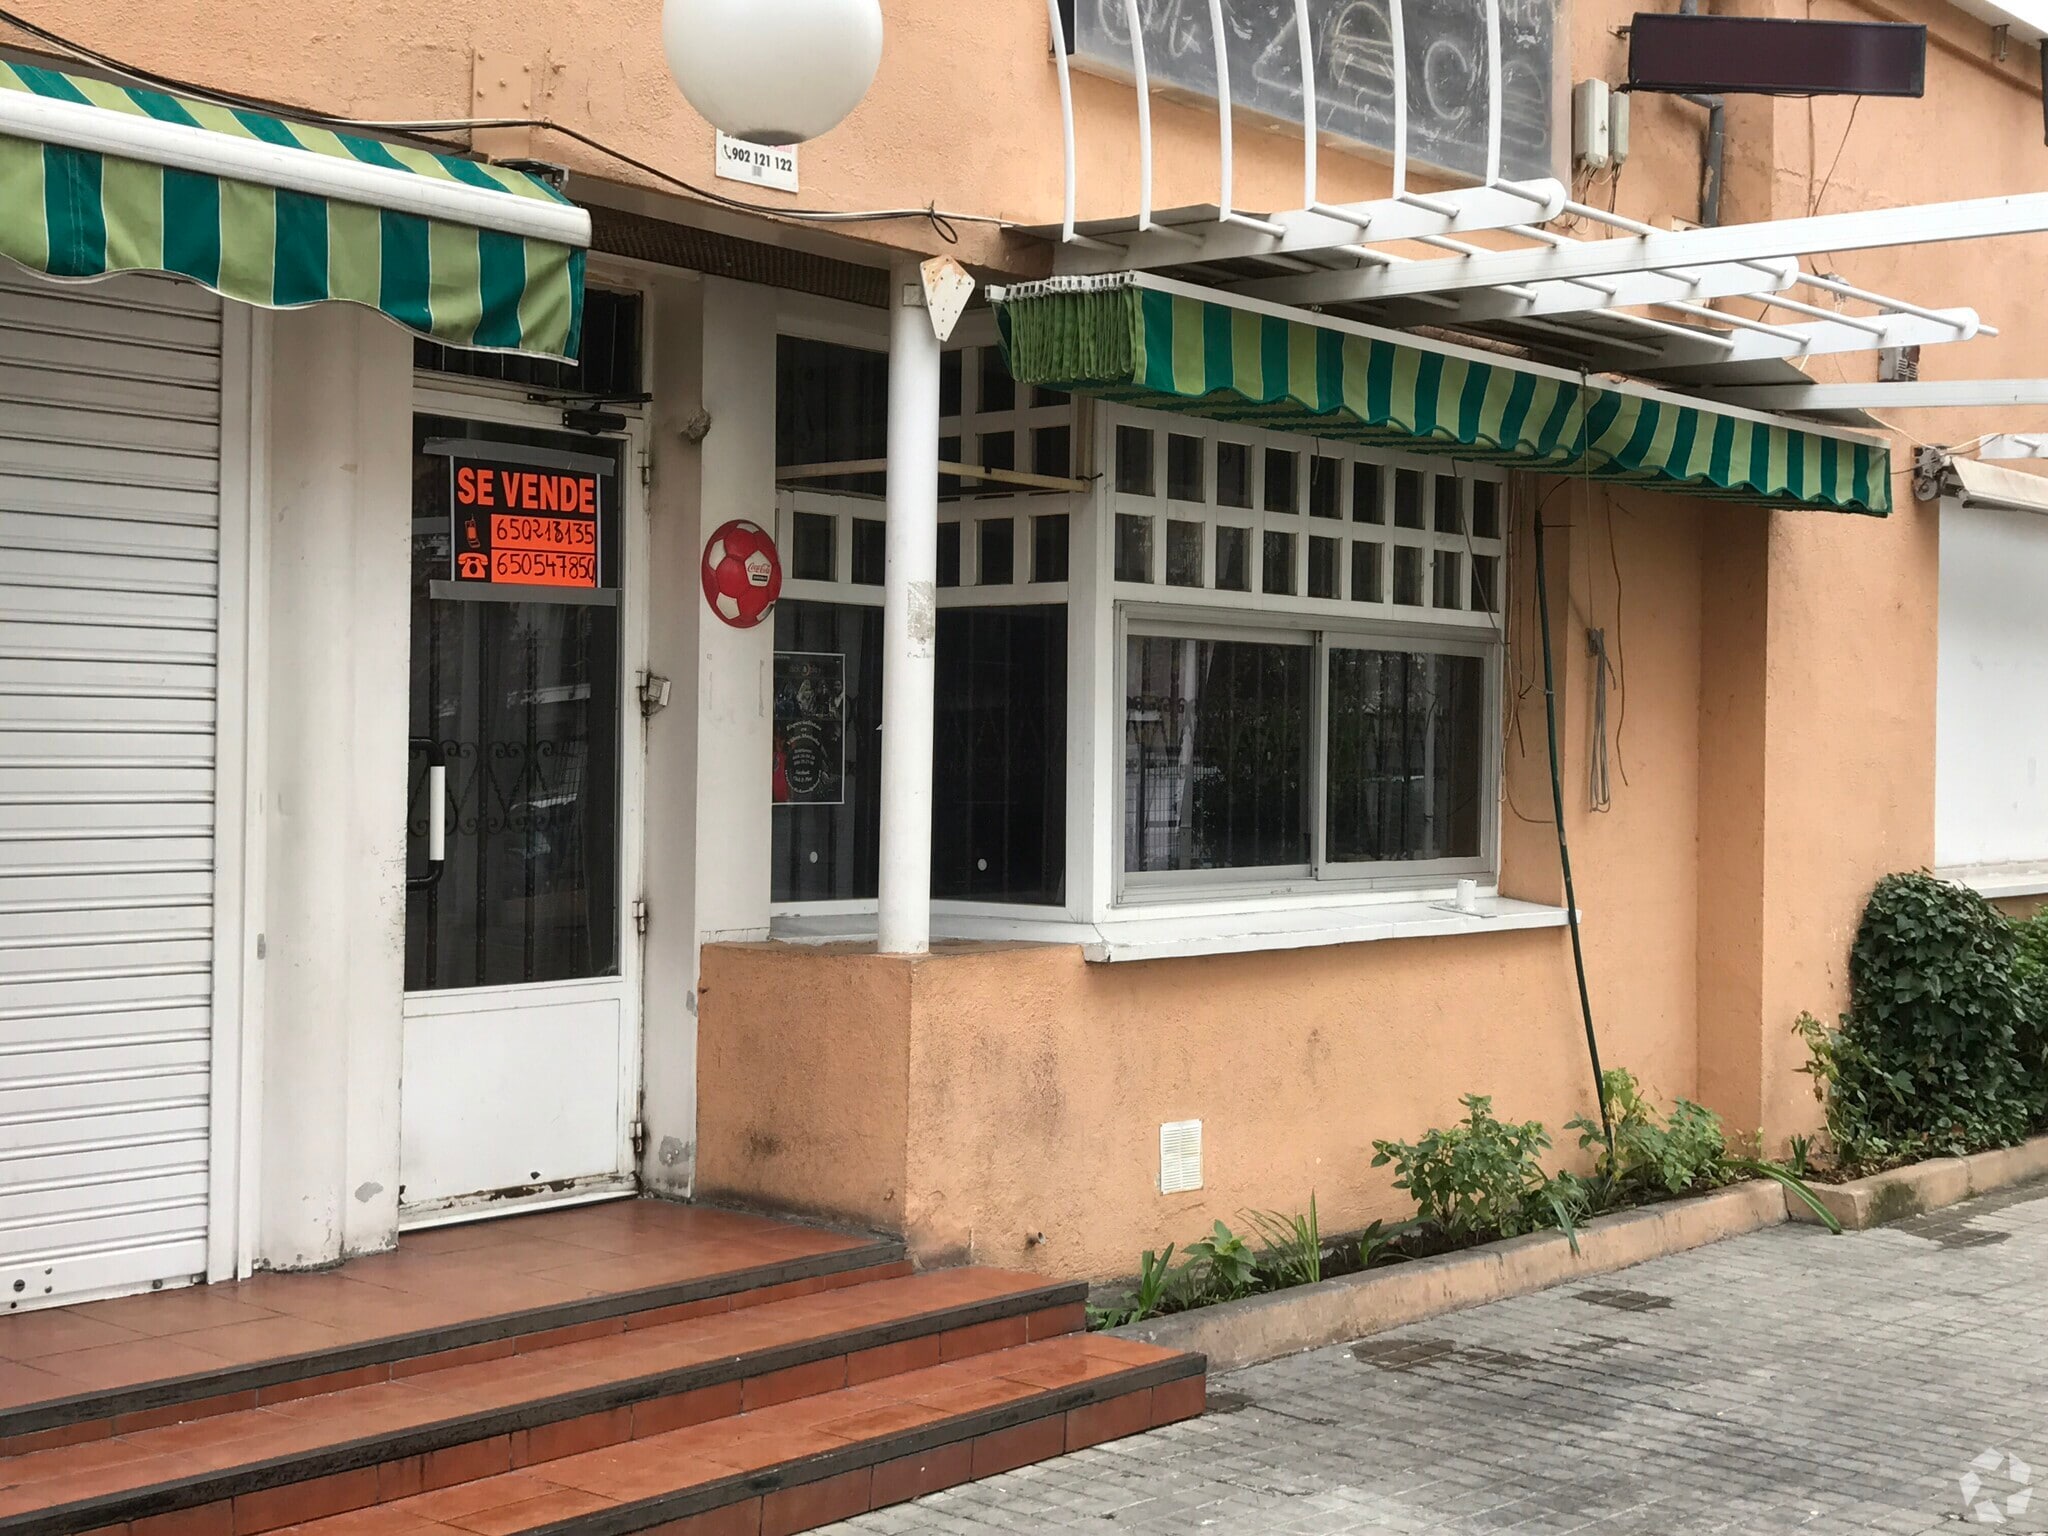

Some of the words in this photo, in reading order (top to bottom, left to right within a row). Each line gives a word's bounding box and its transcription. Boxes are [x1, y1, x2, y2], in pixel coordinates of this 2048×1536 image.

[732, 147, 751, 163] 902
[754, 152, 771, 168] 121
[775, 157, 793, 173] 122
[457, 467, 494, 506] SE
[501, 471, 595, 514] VENDE
